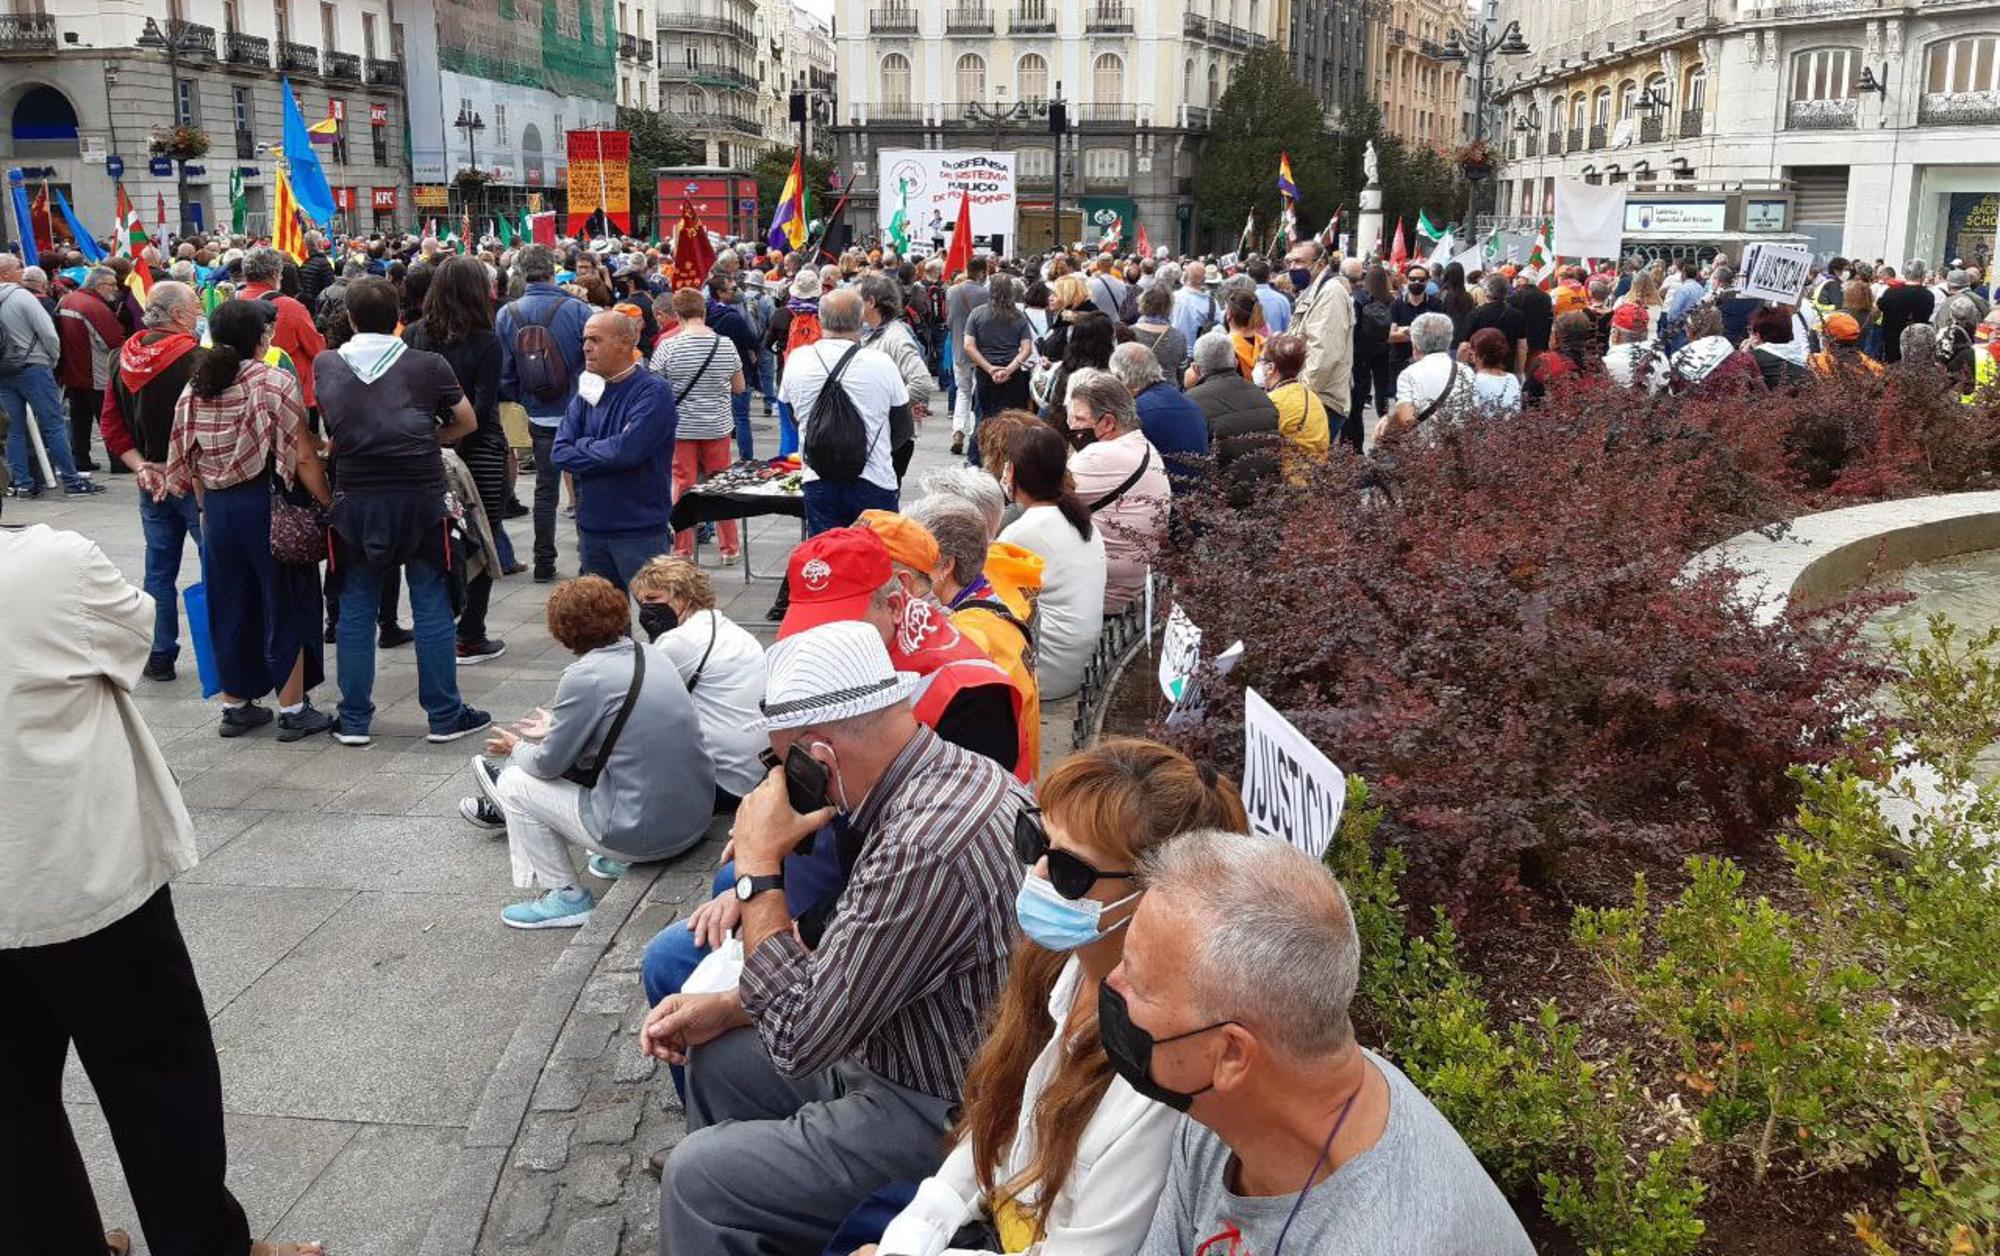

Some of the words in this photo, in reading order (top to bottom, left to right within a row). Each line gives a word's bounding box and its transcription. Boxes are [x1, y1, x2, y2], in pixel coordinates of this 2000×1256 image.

[371, 109, 387, 121] KFC
[953, 157, 1008, 171] DEFENSA
[955, 170, 1008, 181] SISTEMA
[375, 191, 393, 204] KFC
